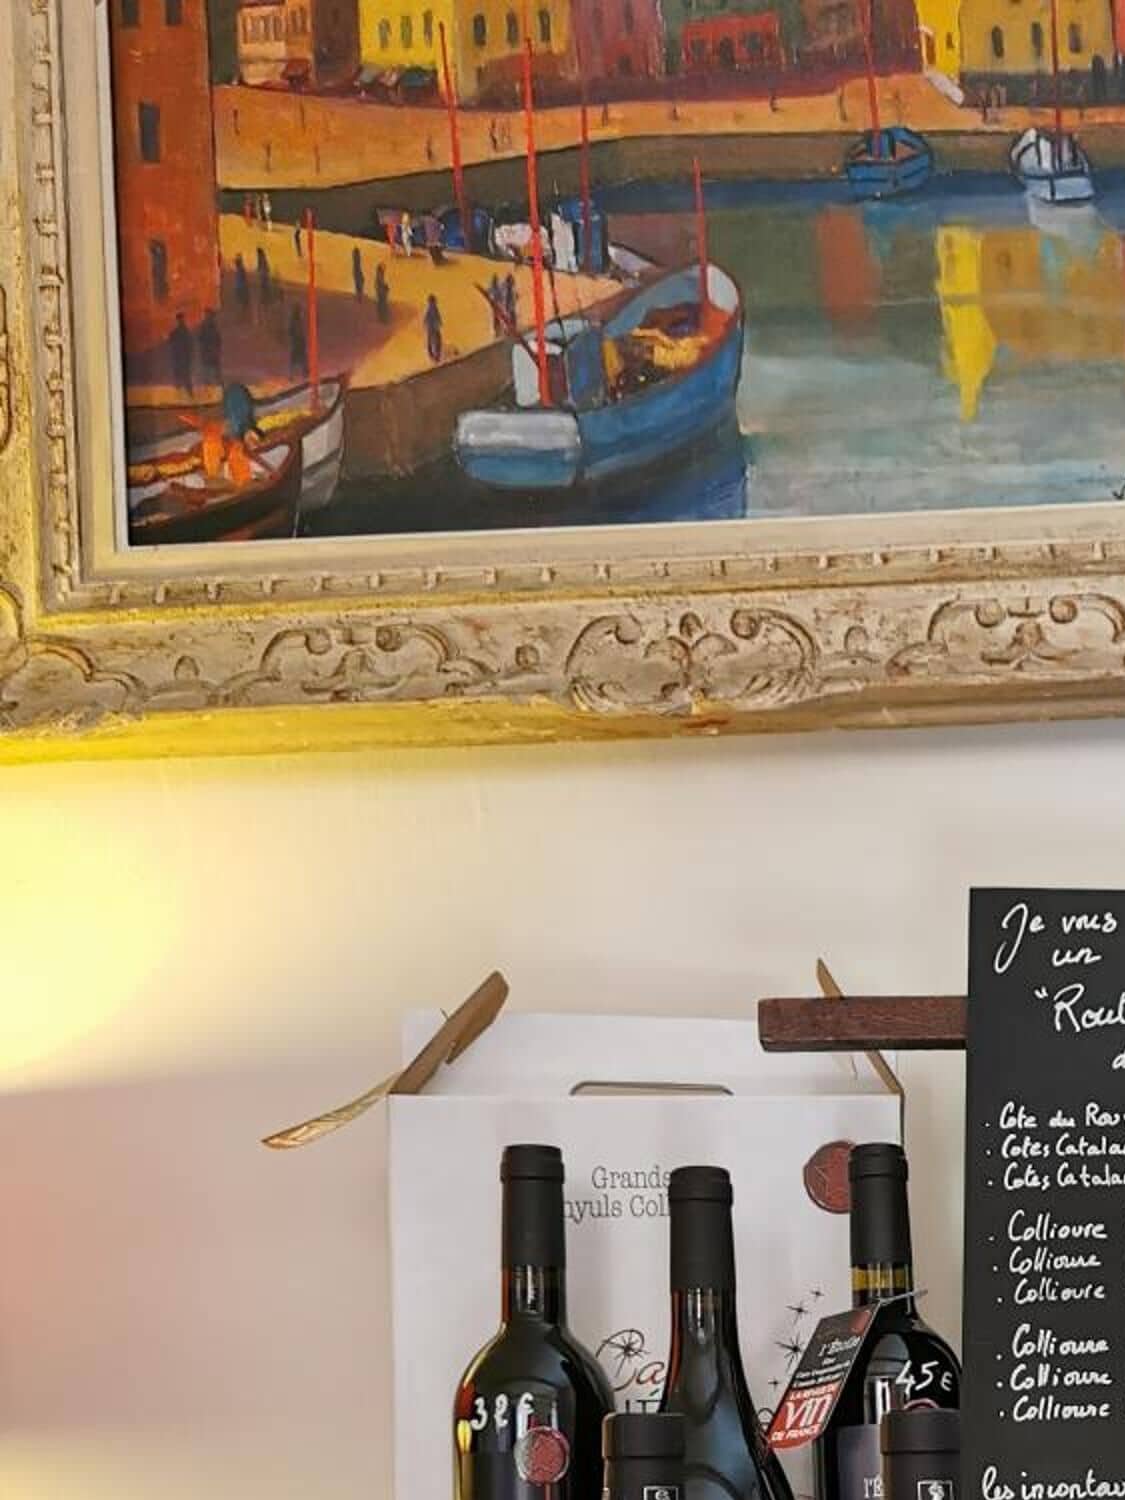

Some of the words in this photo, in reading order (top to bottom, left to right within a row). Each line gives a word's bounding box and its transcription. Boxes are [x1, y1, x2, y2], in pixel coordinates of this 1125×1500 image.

[994, 903, 1045, 973] Je
[1062, 912, 1118, 934] vous
[1052, 947, 1101, 967] un
[1050, 1111, 1075, 1128] du
[1008, 1209, 1107, 1242] Collioure
[1009, 1246, 1101, 1274] Collioure
[1014, 1278, 1105, 1305] Collioure
[1012, 1323, 1109, 1358] Collioure
[1010, 1364, 1112, 1391] Collioure
[1013, 1395, 1110, 1421] Collioure
